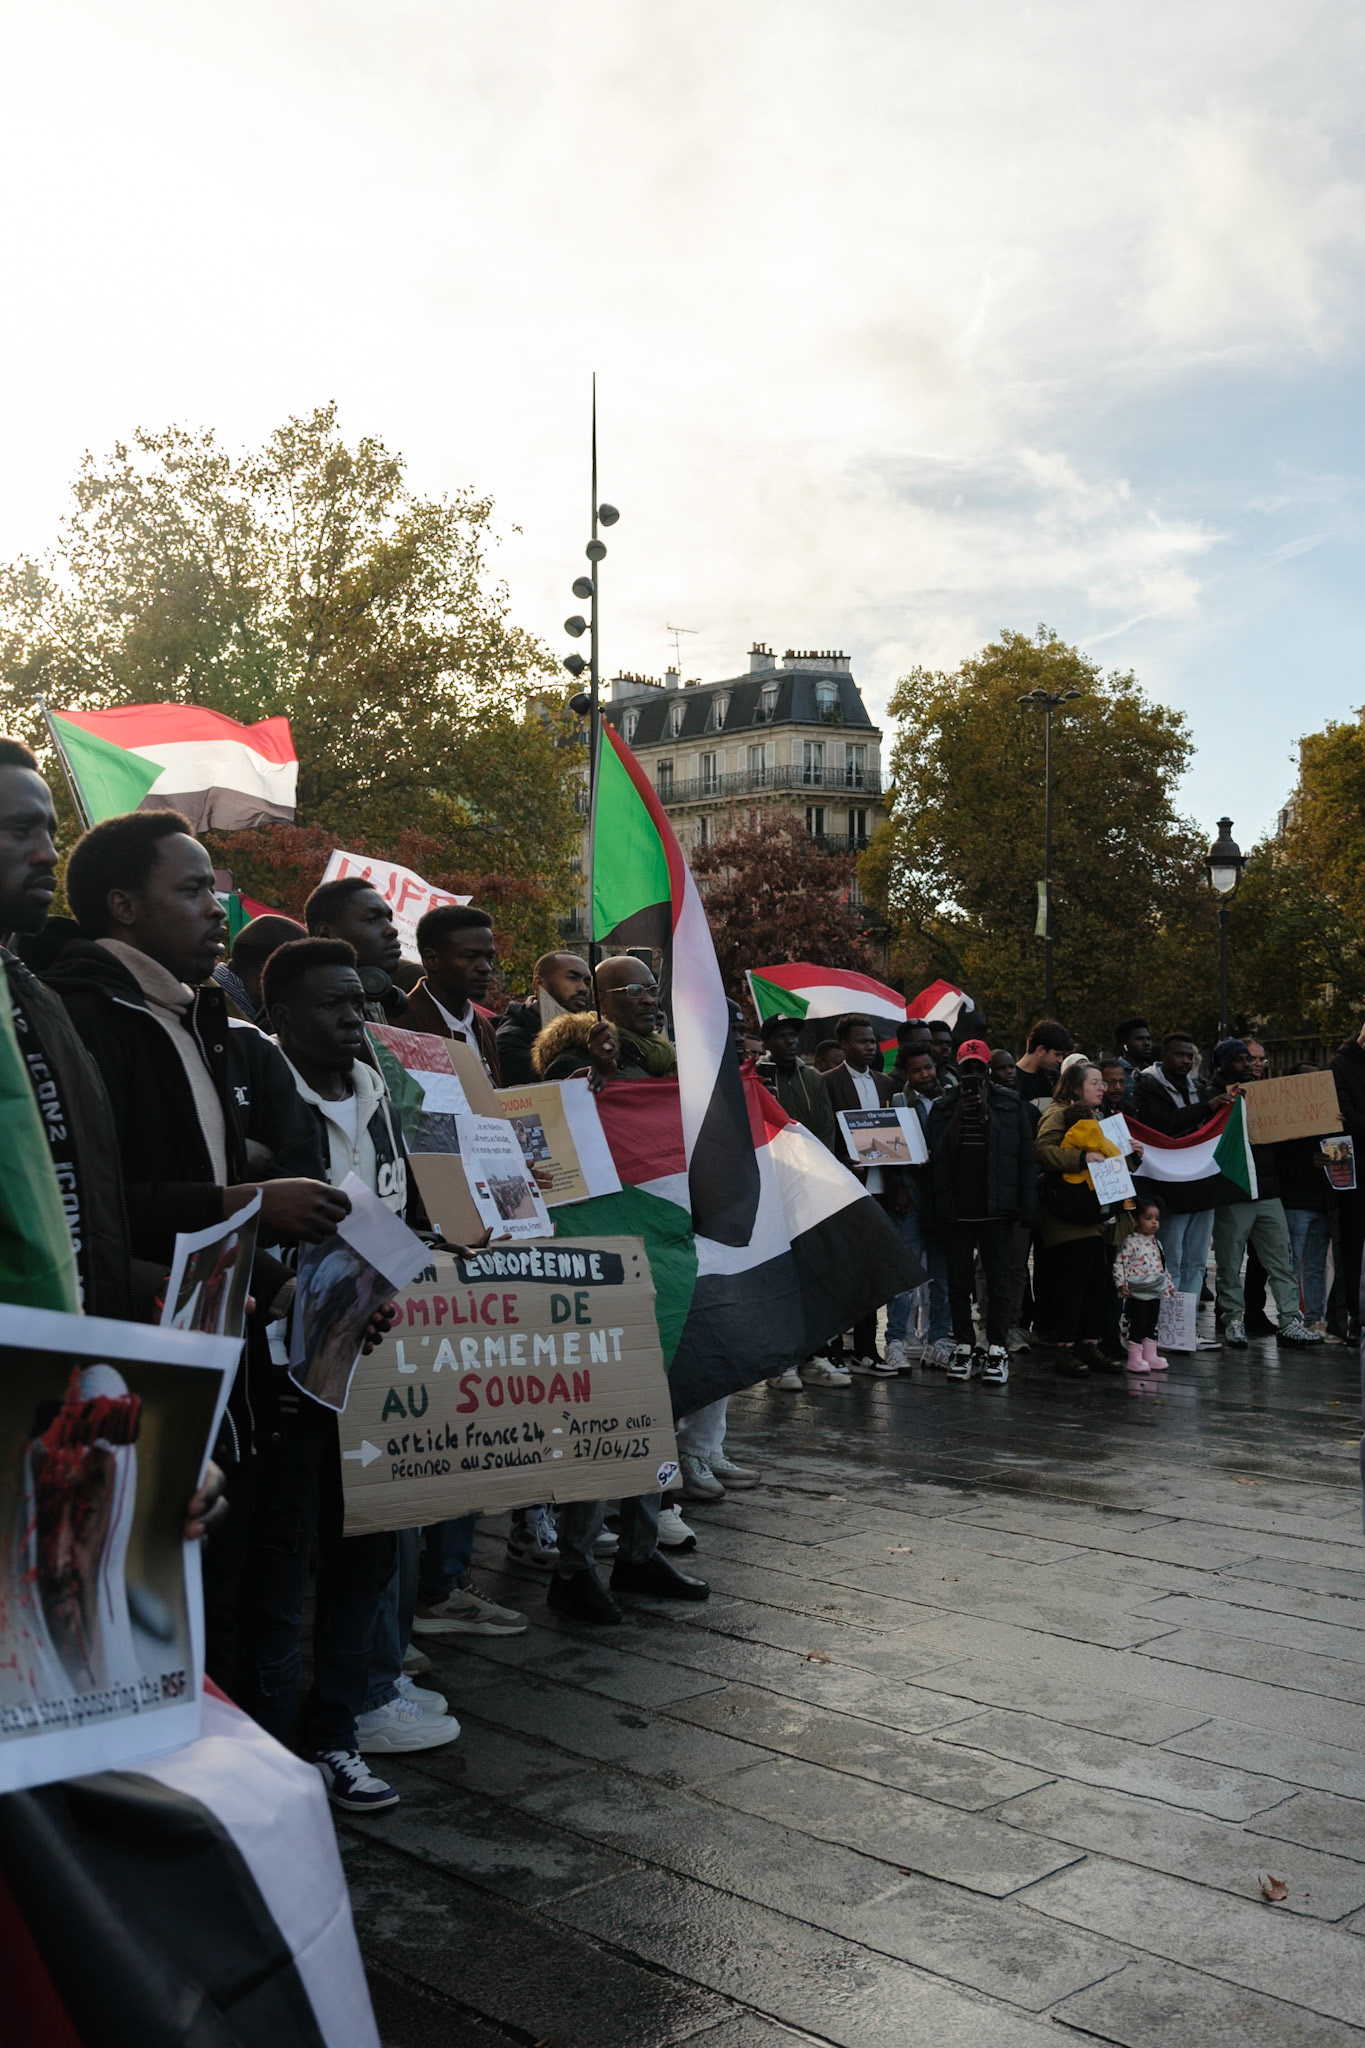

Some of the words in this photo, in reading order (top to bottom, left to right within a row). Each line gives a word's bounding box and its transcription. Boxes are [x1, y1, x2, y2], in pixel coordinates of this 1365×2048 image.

[26, 1052, 67, 1143] ICON2
[856, 1120, 873, 1128] Sudan
[389, 1290, 520, 1327] OMPLICE
[550, 1291, 592, 1325] DE
[396, 1328, 624, 1374] L'ARMEMENT
[381, 1383, 429, 1421] AU
[456, 1370, 591, 1413] SOUDAN
[387, 1423, 459, 1454] article
[466, 1422, 518, 1447] France
[522, 1422, 545, 1443] 24
[626, 1414, 657, 1429] euro-
[391, 1458, 451, 1480] péennes
[461, 1455, 479, 1470] au
[573, 1437, 650, 1461] 17/04/25
[72, 1681, 139, 1726] sponsoring
[139, 1675, 160, 1705] the
[160, 1670, 186, 1699] RSF
